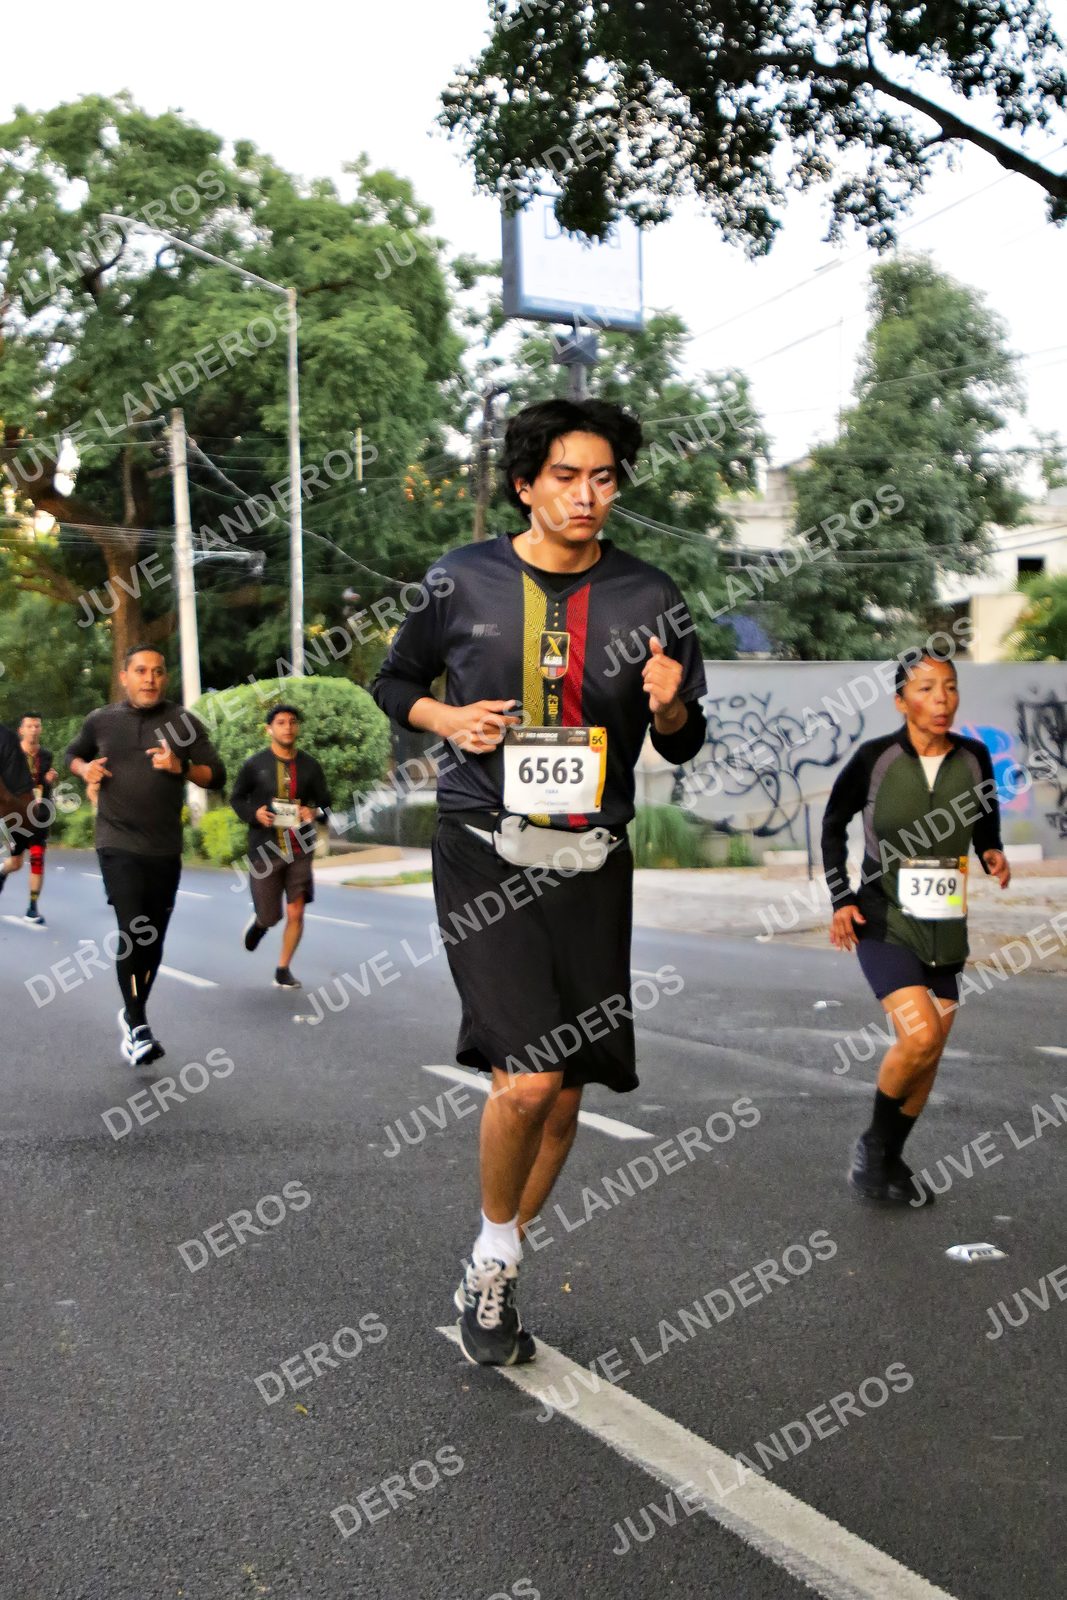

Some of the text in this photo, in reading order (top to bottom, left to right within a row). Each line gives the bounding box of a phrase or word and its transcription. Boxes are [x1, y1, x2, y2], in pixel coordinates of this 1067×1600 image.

[591, 735, 603, 745] 5K
[518, 757, 584, 784] 6563
[911, 877, 957, 896] 3769
